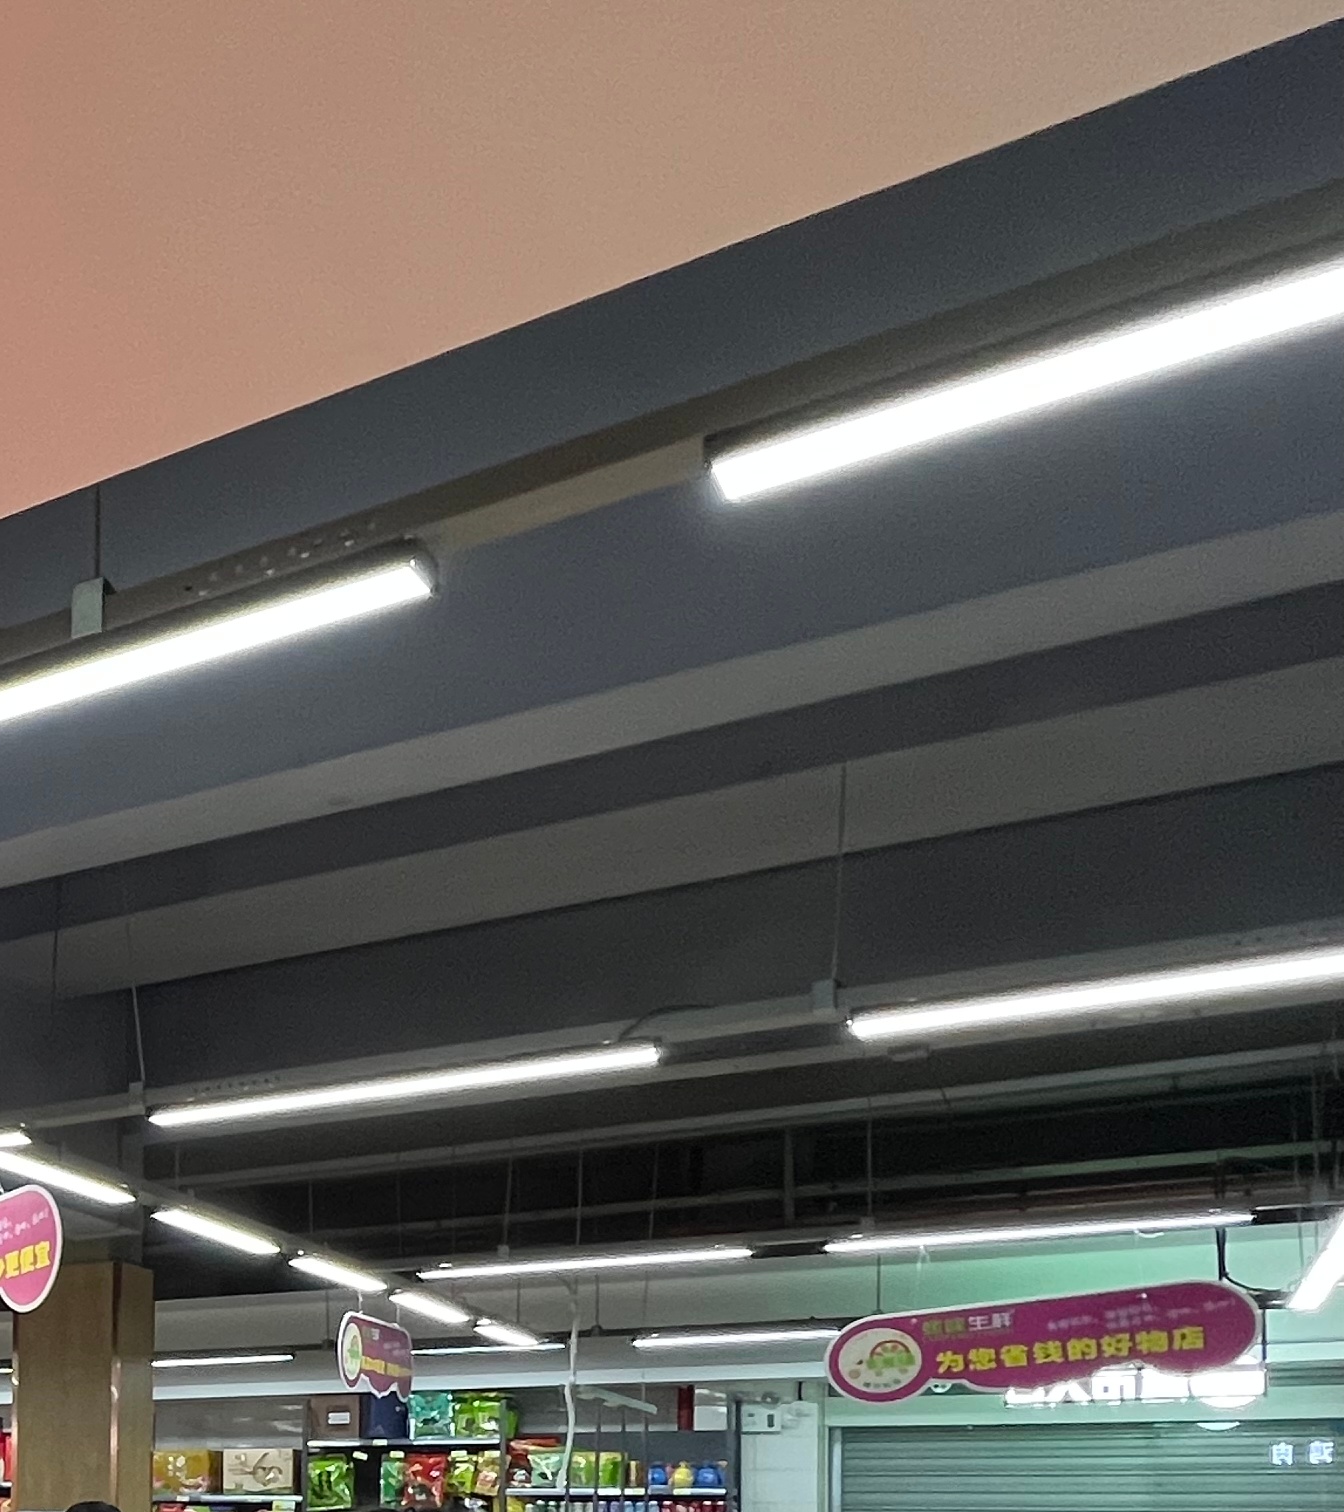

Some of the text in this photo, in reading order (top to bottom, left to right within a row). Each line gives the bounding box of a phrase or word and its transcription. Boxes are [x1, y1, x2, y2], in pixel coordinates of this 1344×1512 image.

[936, 1326, 1205, 1375] 为您省钱的好物店
